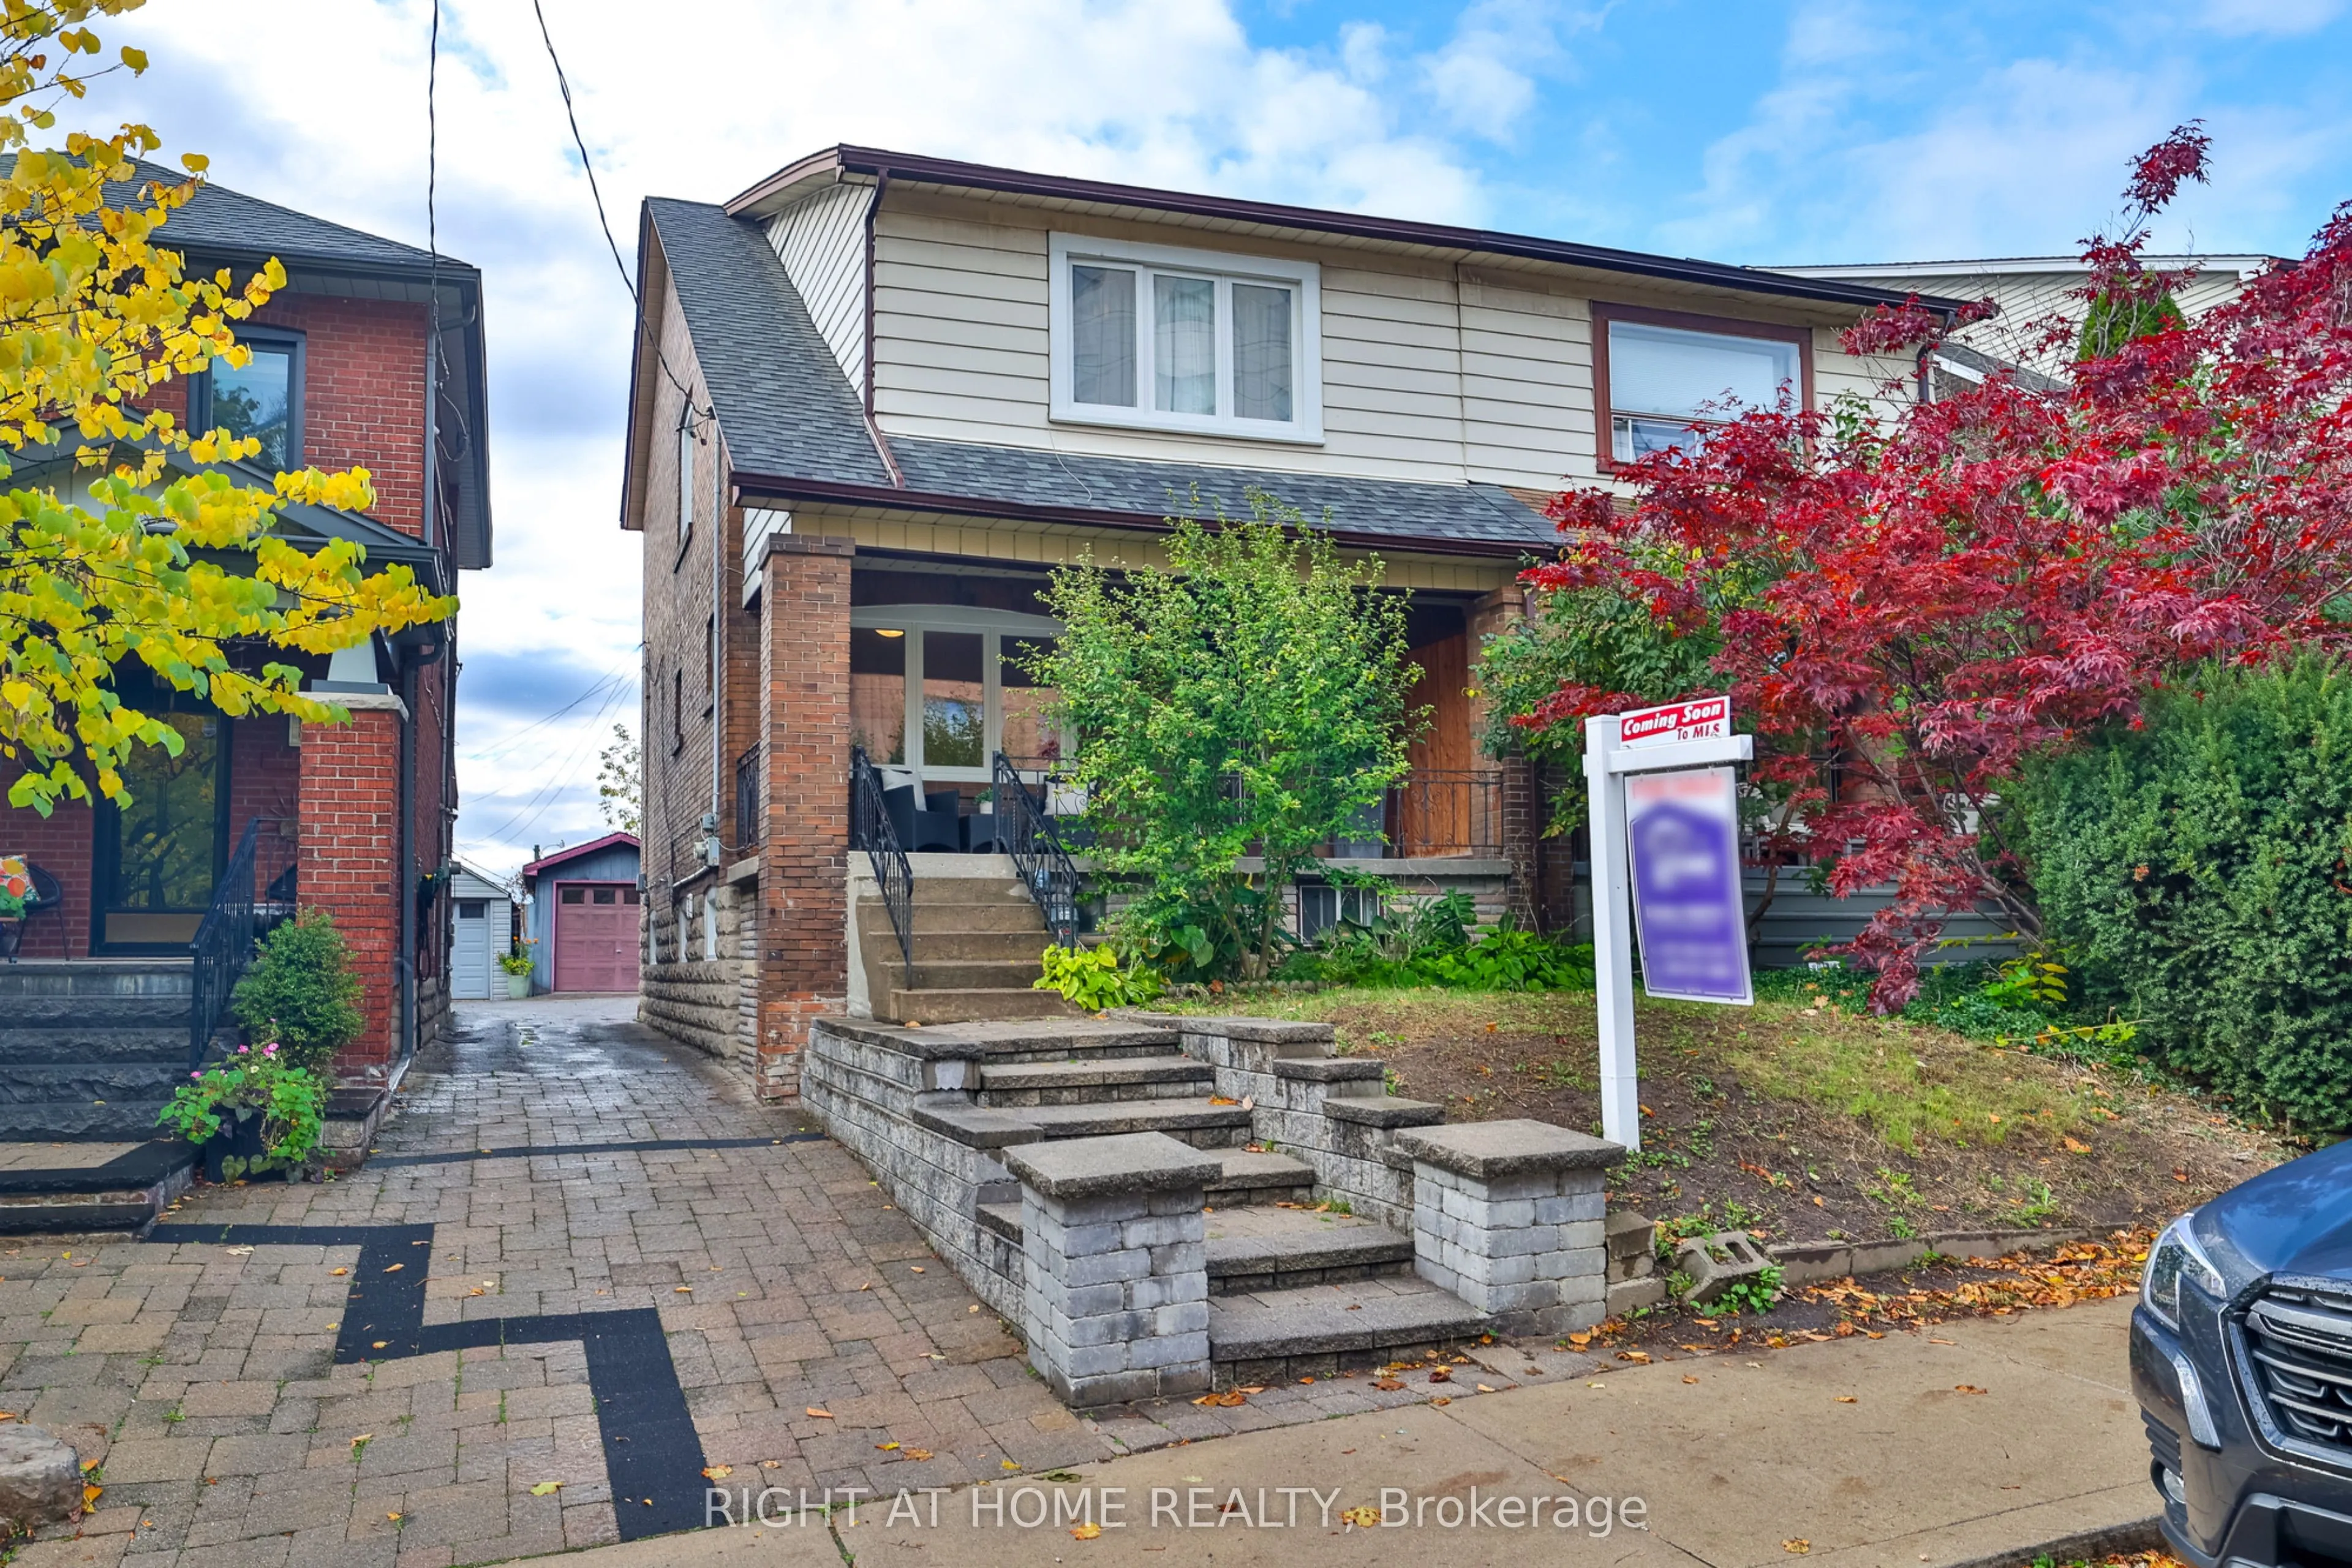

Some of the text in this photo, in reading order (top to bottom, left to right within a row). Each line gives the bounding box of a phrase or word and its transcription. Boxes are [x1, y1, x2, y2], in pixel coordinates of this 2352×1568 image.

[1624, 703, 1722, 736] Coming Soon
[1677, 727, 1688, 741] To
